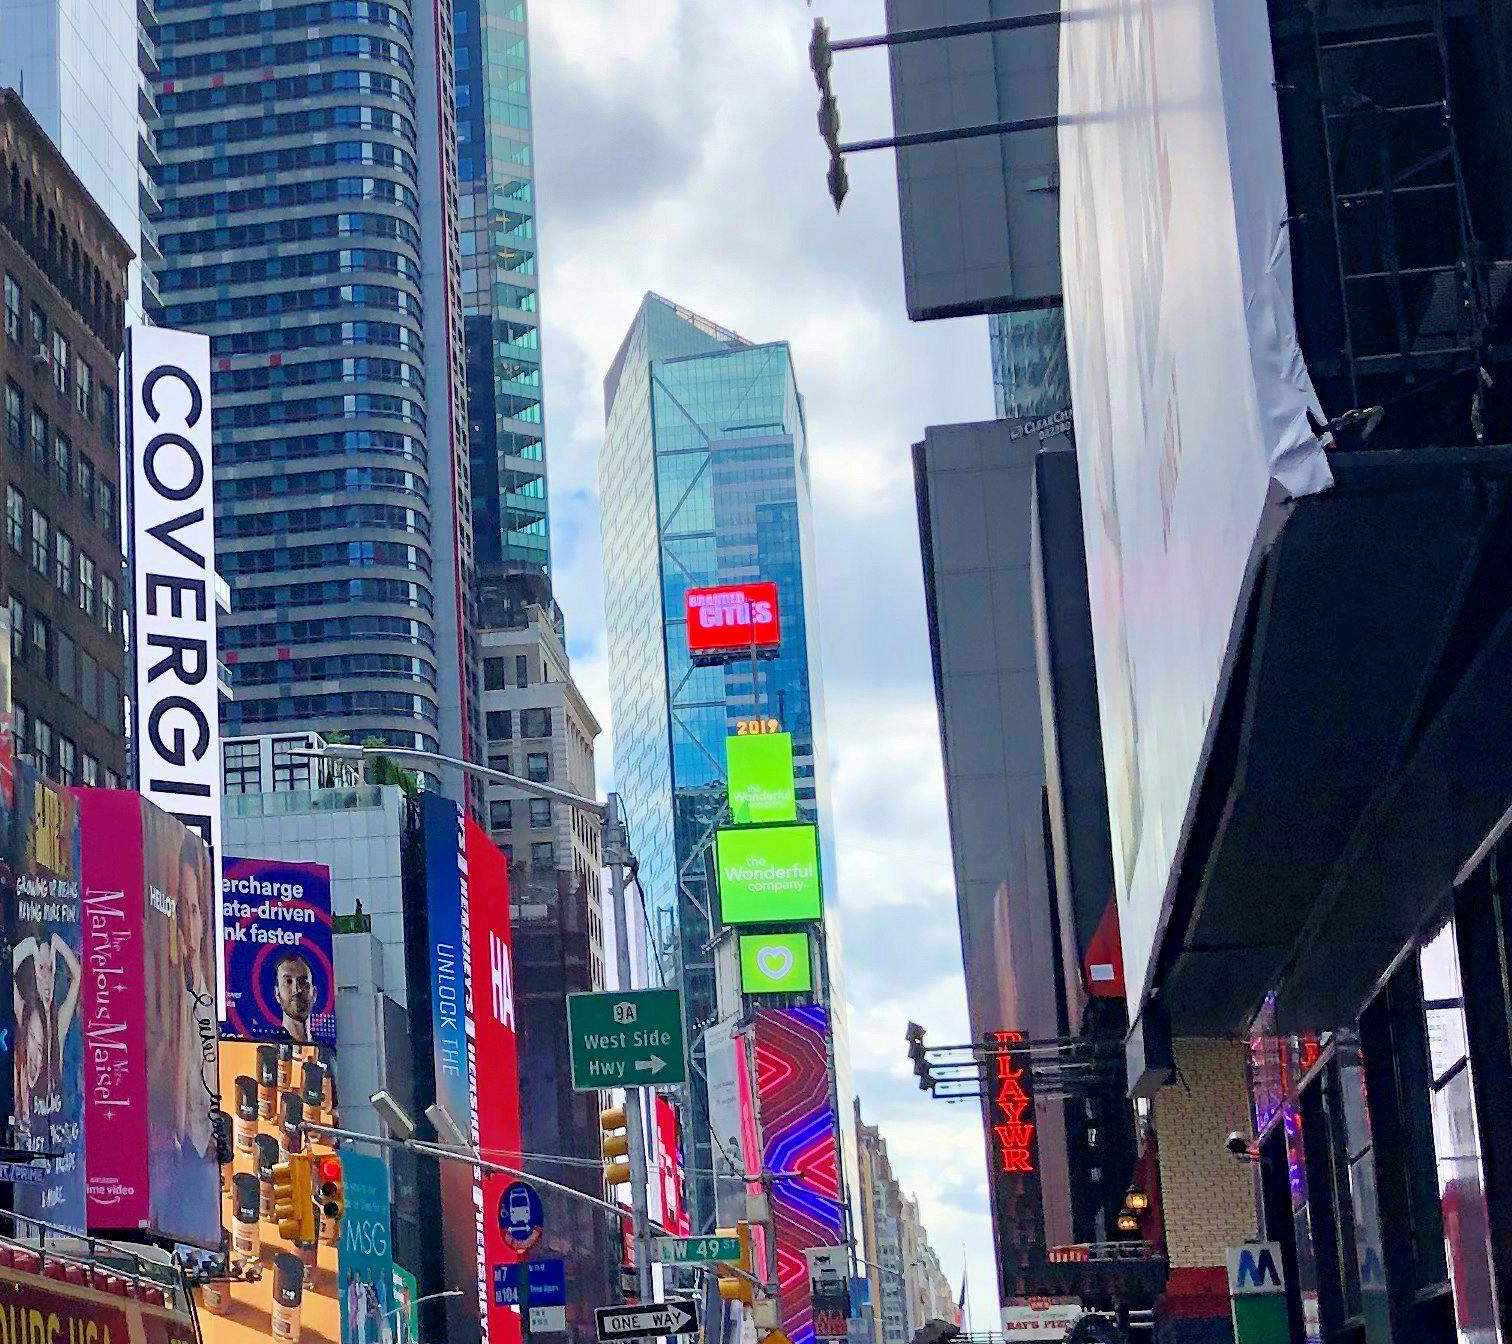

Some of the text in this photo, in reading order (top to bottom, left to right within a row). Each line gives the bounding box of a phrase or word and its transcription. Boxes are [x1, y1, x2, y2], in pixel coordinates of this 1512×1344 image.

[736, 719, 780, 736] 2019
[746, 856, 767, 867] the
[724, 863, 813, 882] Wonderful
[222, 876, 304, 902] ercharge
[223, 899, 316, 923] ata-driven
[250, 923, 303, 946] faster
[83, 887, 125, 1019] Marvelous
[437, 943, 460, 1077] UNLOCK THE
[616, 1005, 634, 1021] 9A
[584, 1029, 672, 1050] West Side
[86, 1020, 131, 1106] Maisel
[589, 1060, 626, 1078] Hwy
[86, 1184, 135, 1196] ime video
[346, 1219, 387, 1256] MSG
[675, 1238, 737, 1258] W 49 ST
[611, 1312, 682, 1331] ONE WAY
